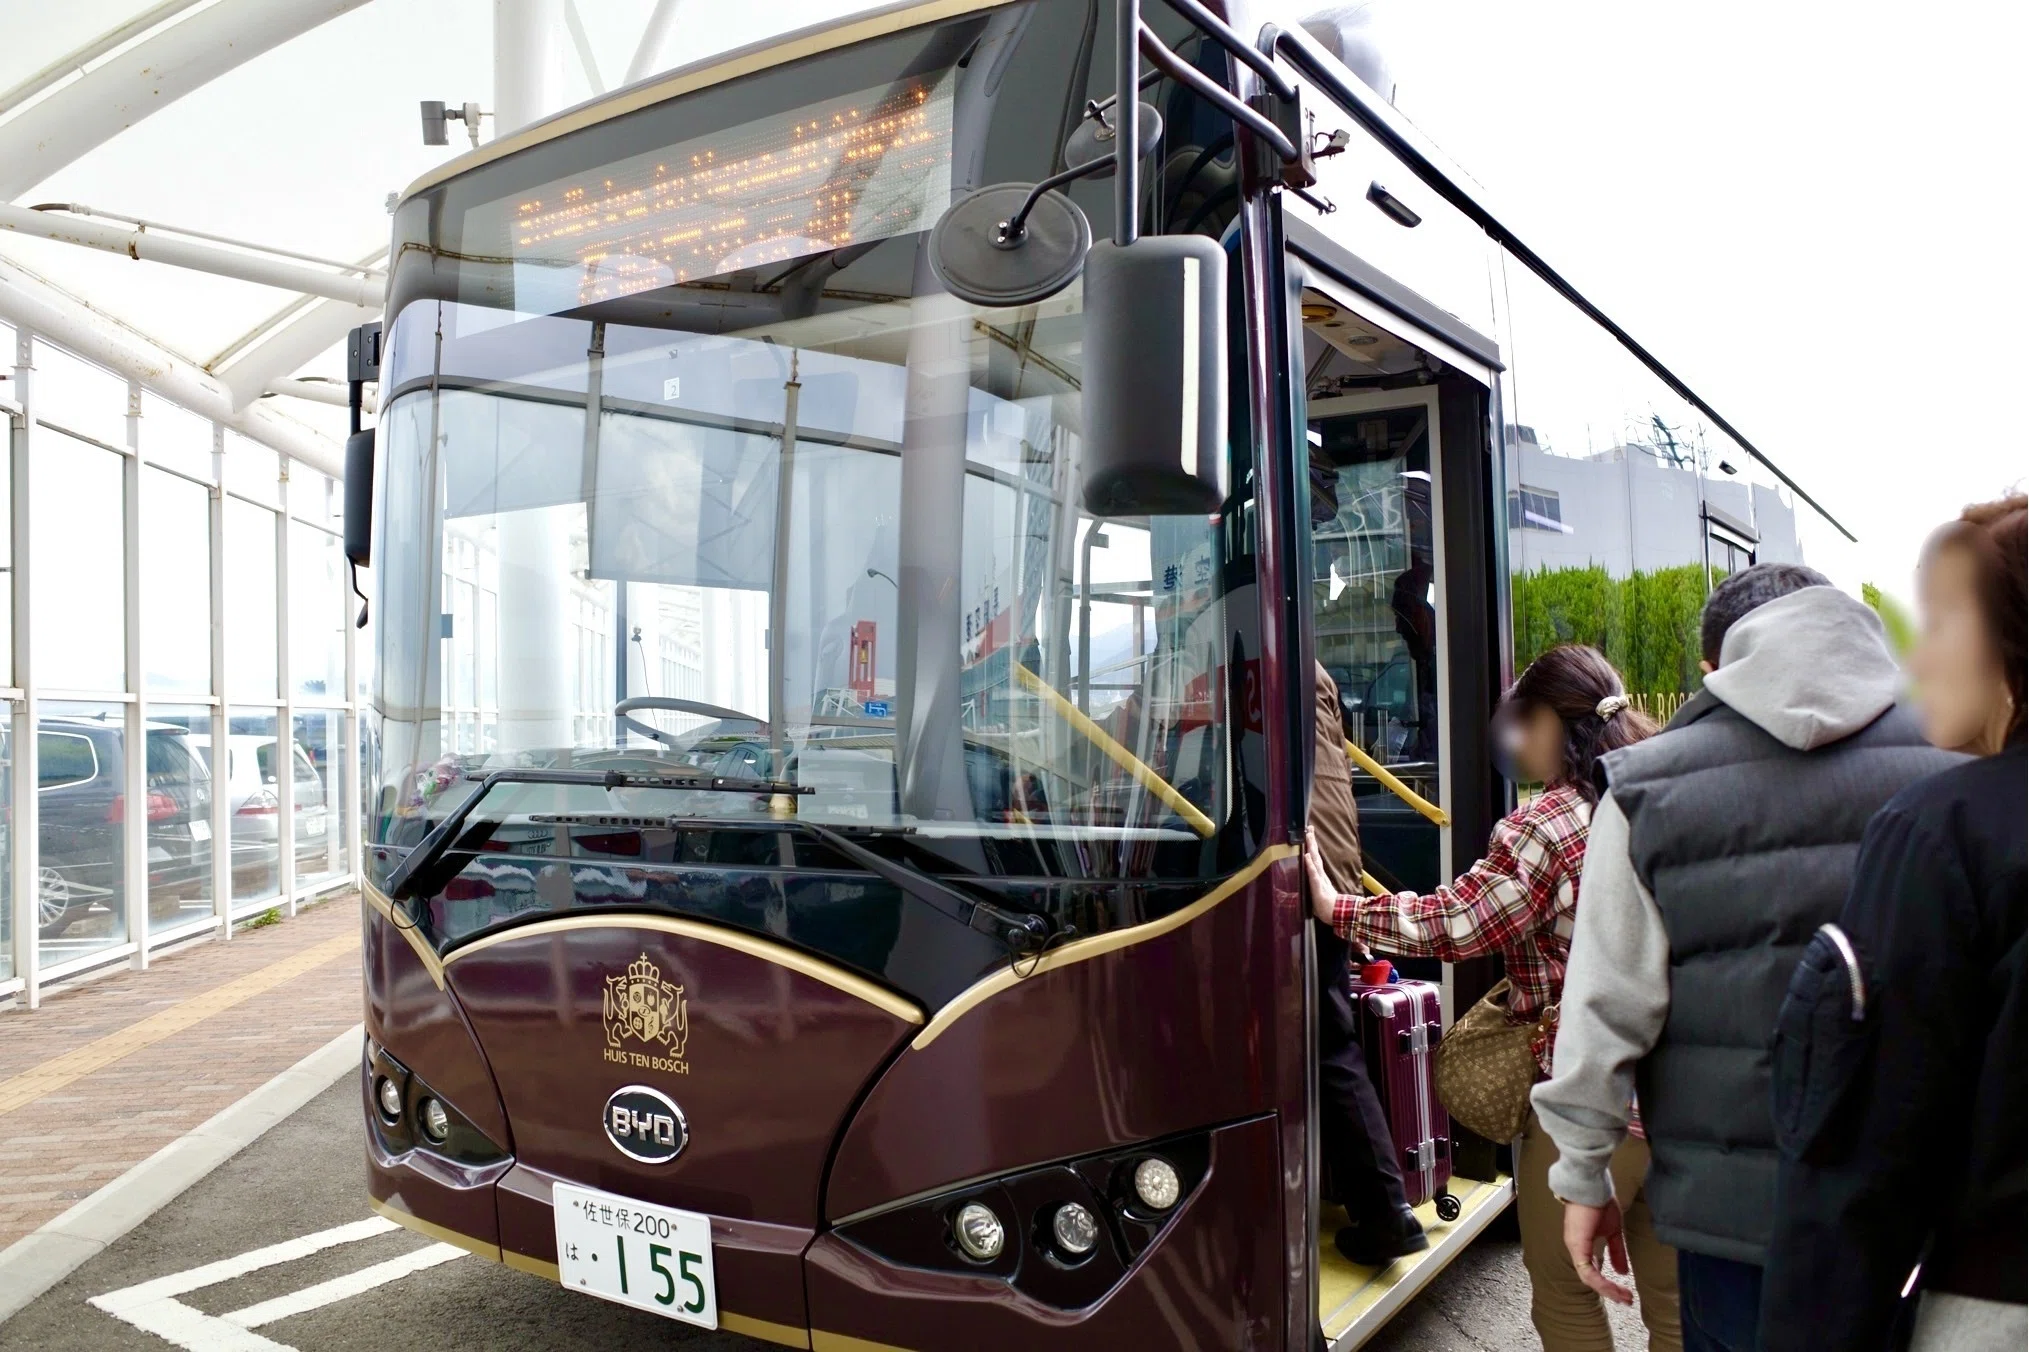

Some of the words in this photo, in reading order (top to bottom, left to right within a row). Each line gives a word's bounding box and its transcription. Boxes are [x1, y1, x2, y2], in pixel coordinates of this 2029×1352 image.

[1656, 691, 1695, 732] BO
[603, 1048, 628, 1064] HUIS
[629, 1053, 650, 1068] TEN
[651, 1056, 689, 1075] BOSCH
[612, 1105, 676, 1147] BYD
[565, 1242, 579, 1261] は
